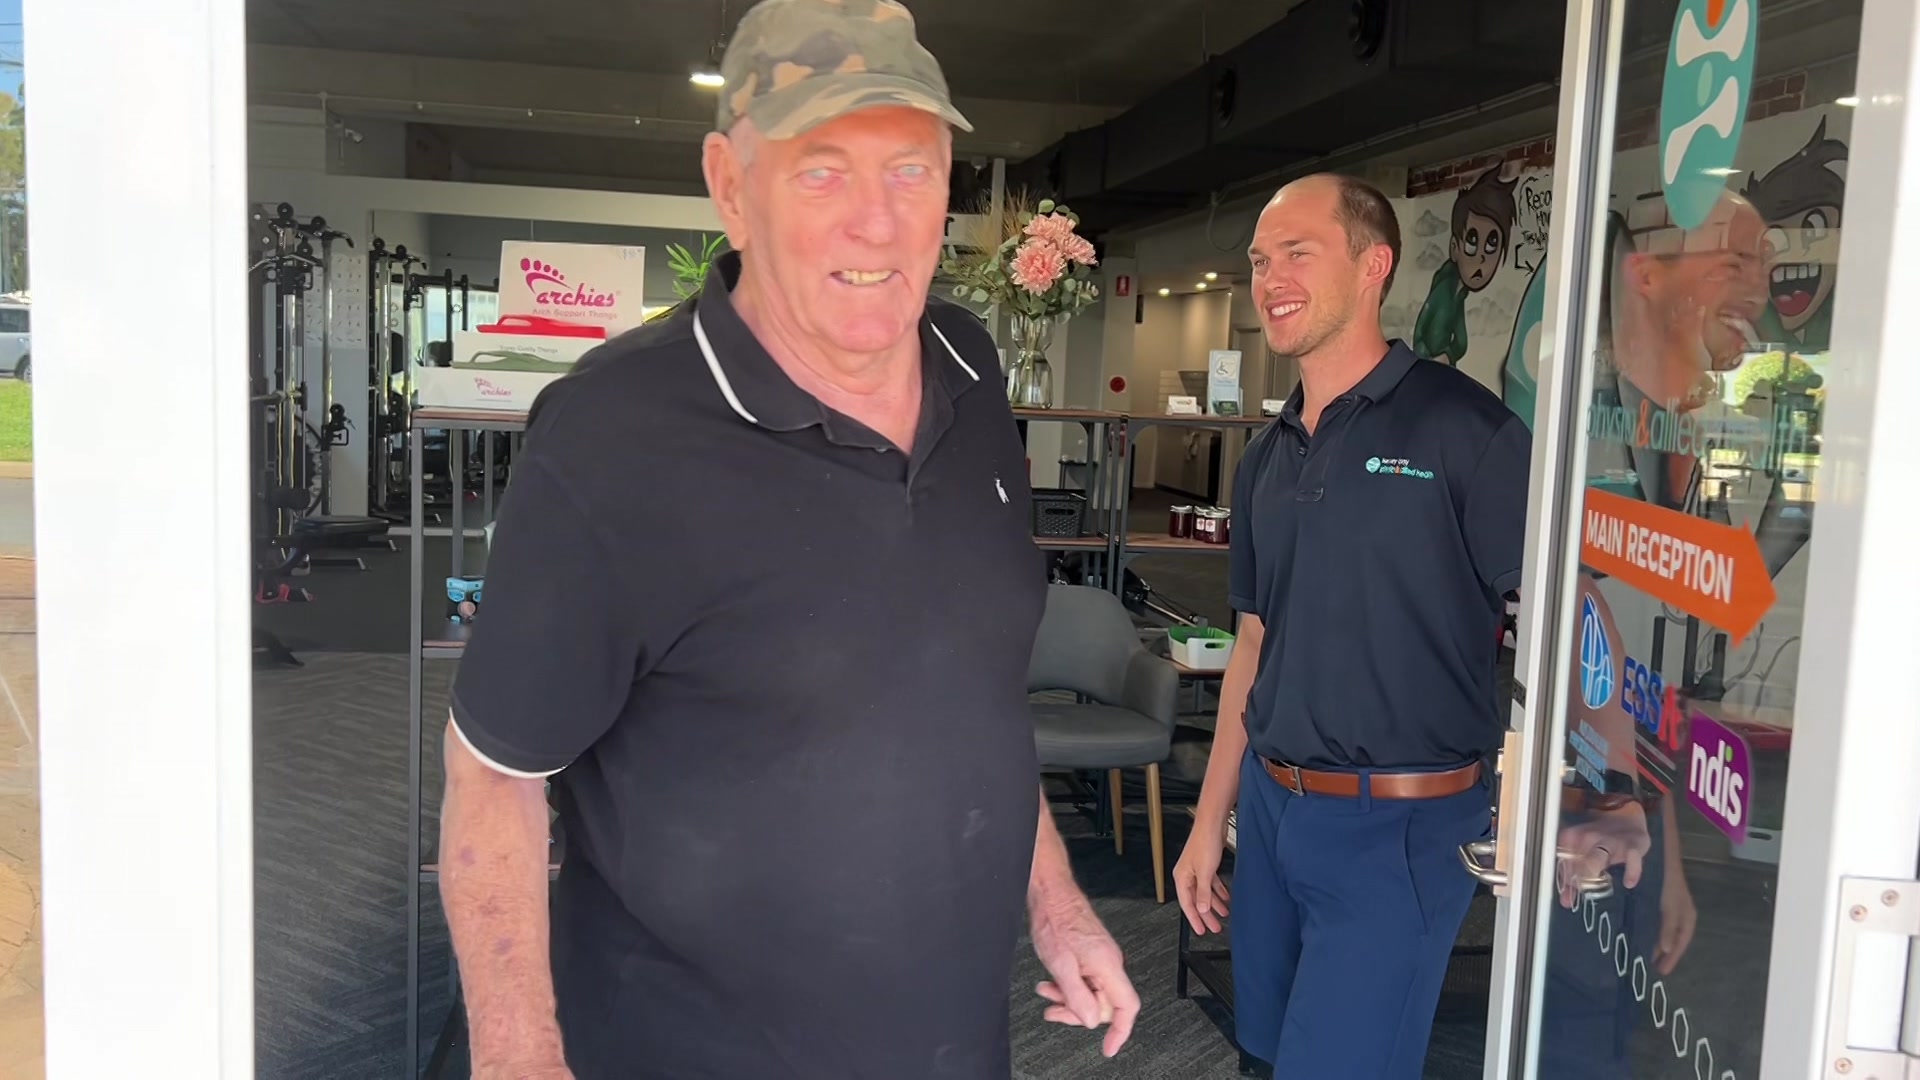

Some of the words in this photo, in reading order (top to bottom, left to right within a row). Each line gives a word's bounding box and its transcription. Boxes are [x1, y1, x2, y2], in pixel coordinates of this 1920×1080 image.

[536, 282, 616, 308] archies
[554, 308, 586, 319] Support
[1586, 509, 1625, 558] MAIN
[1626, 523, 1734, 604] RECEPTION
[1689, 738, 1744, 828] ndis
